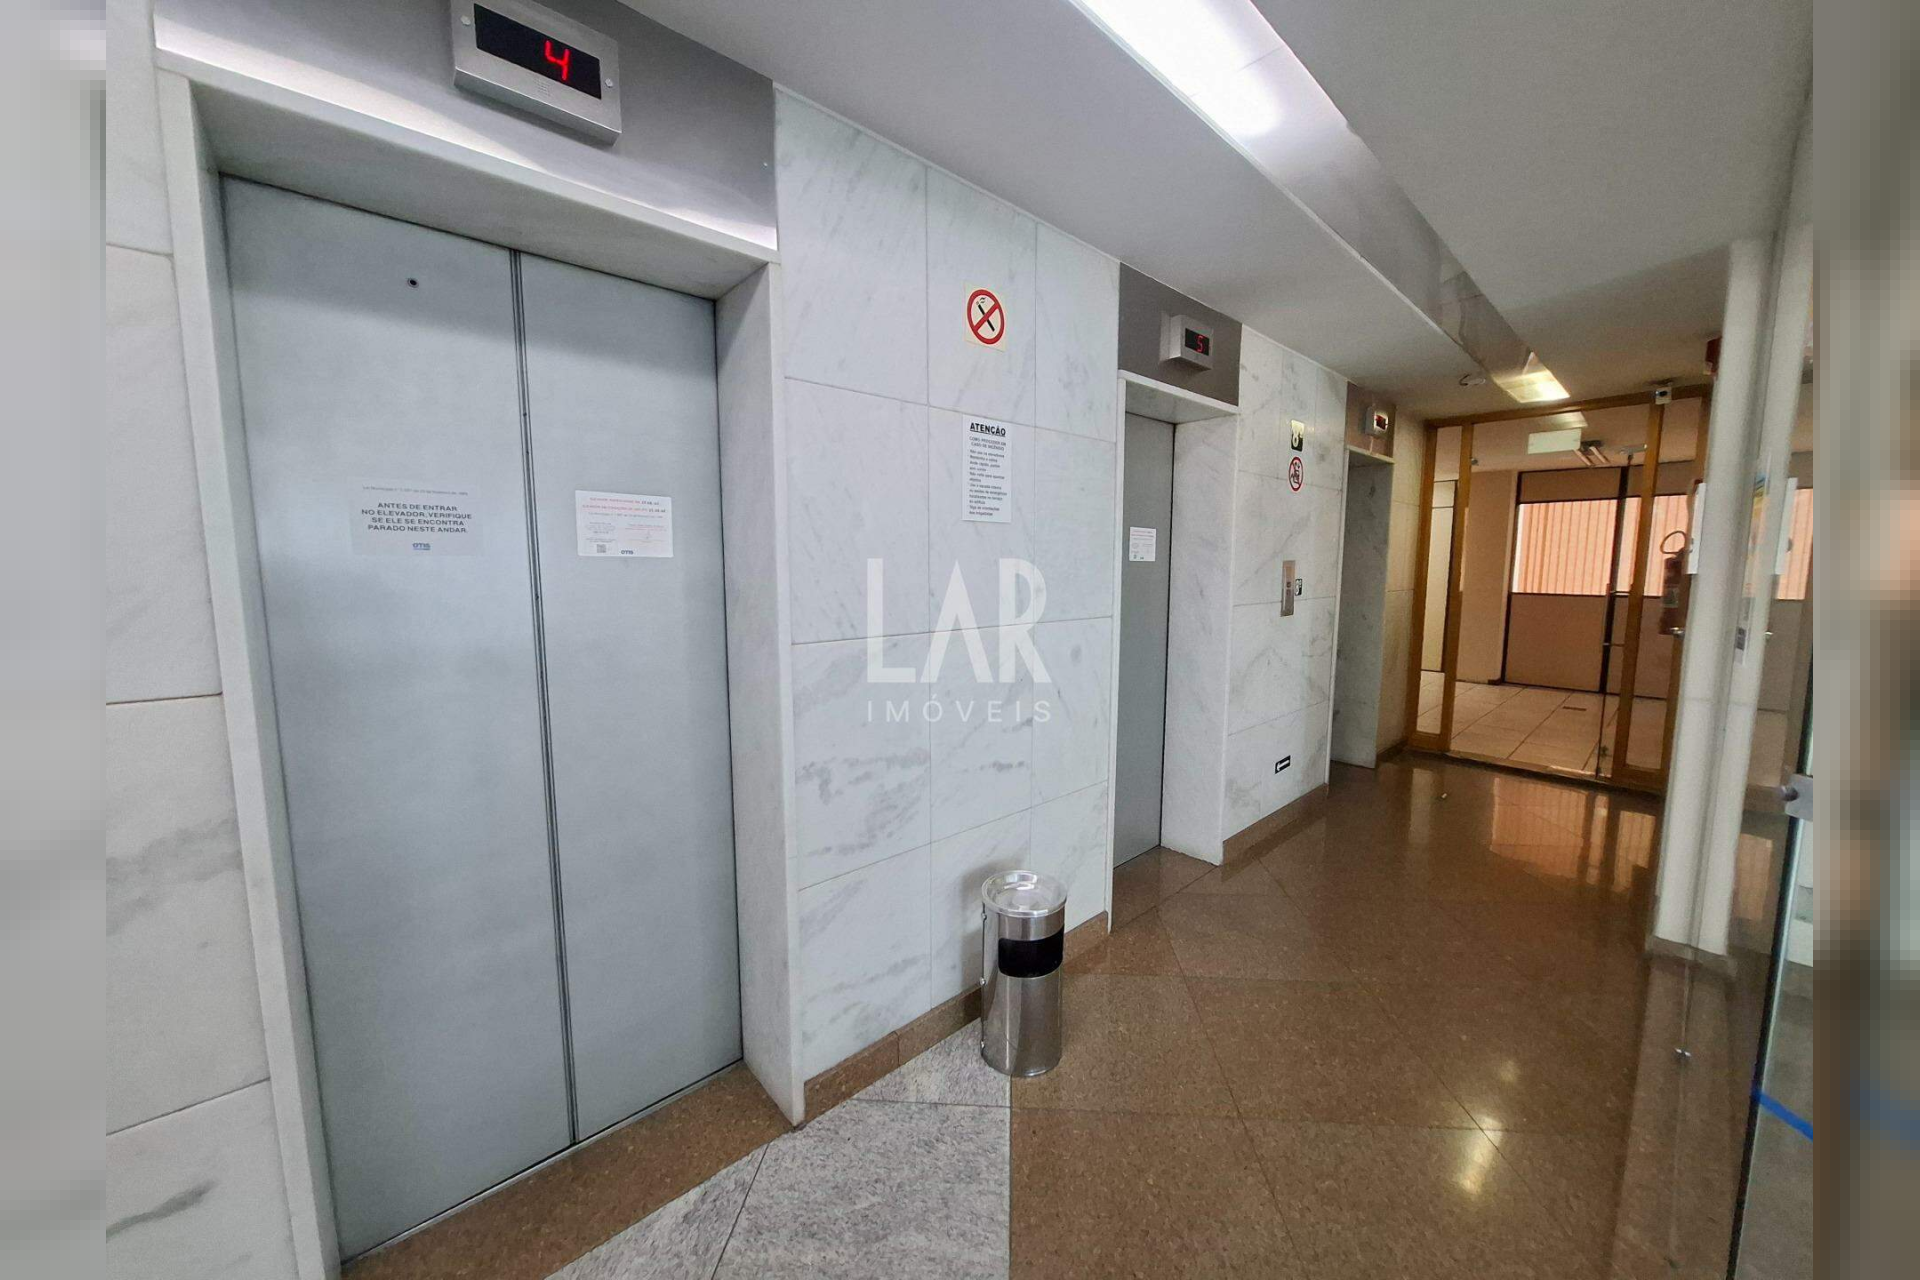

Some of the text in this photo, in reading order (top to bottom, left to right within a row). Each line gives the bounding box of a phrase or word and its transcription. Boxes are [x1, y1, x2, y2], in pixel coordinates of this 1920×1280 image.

[545, 40, 570, 80] 4
[377, 502, 408, 510] ANTES
[422, 504, 458, 512] ENTRAR
[361, 508, 375, 516] NO
[427, 511, 472, 520] VERIFIQUE
[417, 518, 464, 526] ENCONTRA
[368, 524, 406, 532] PARADO
